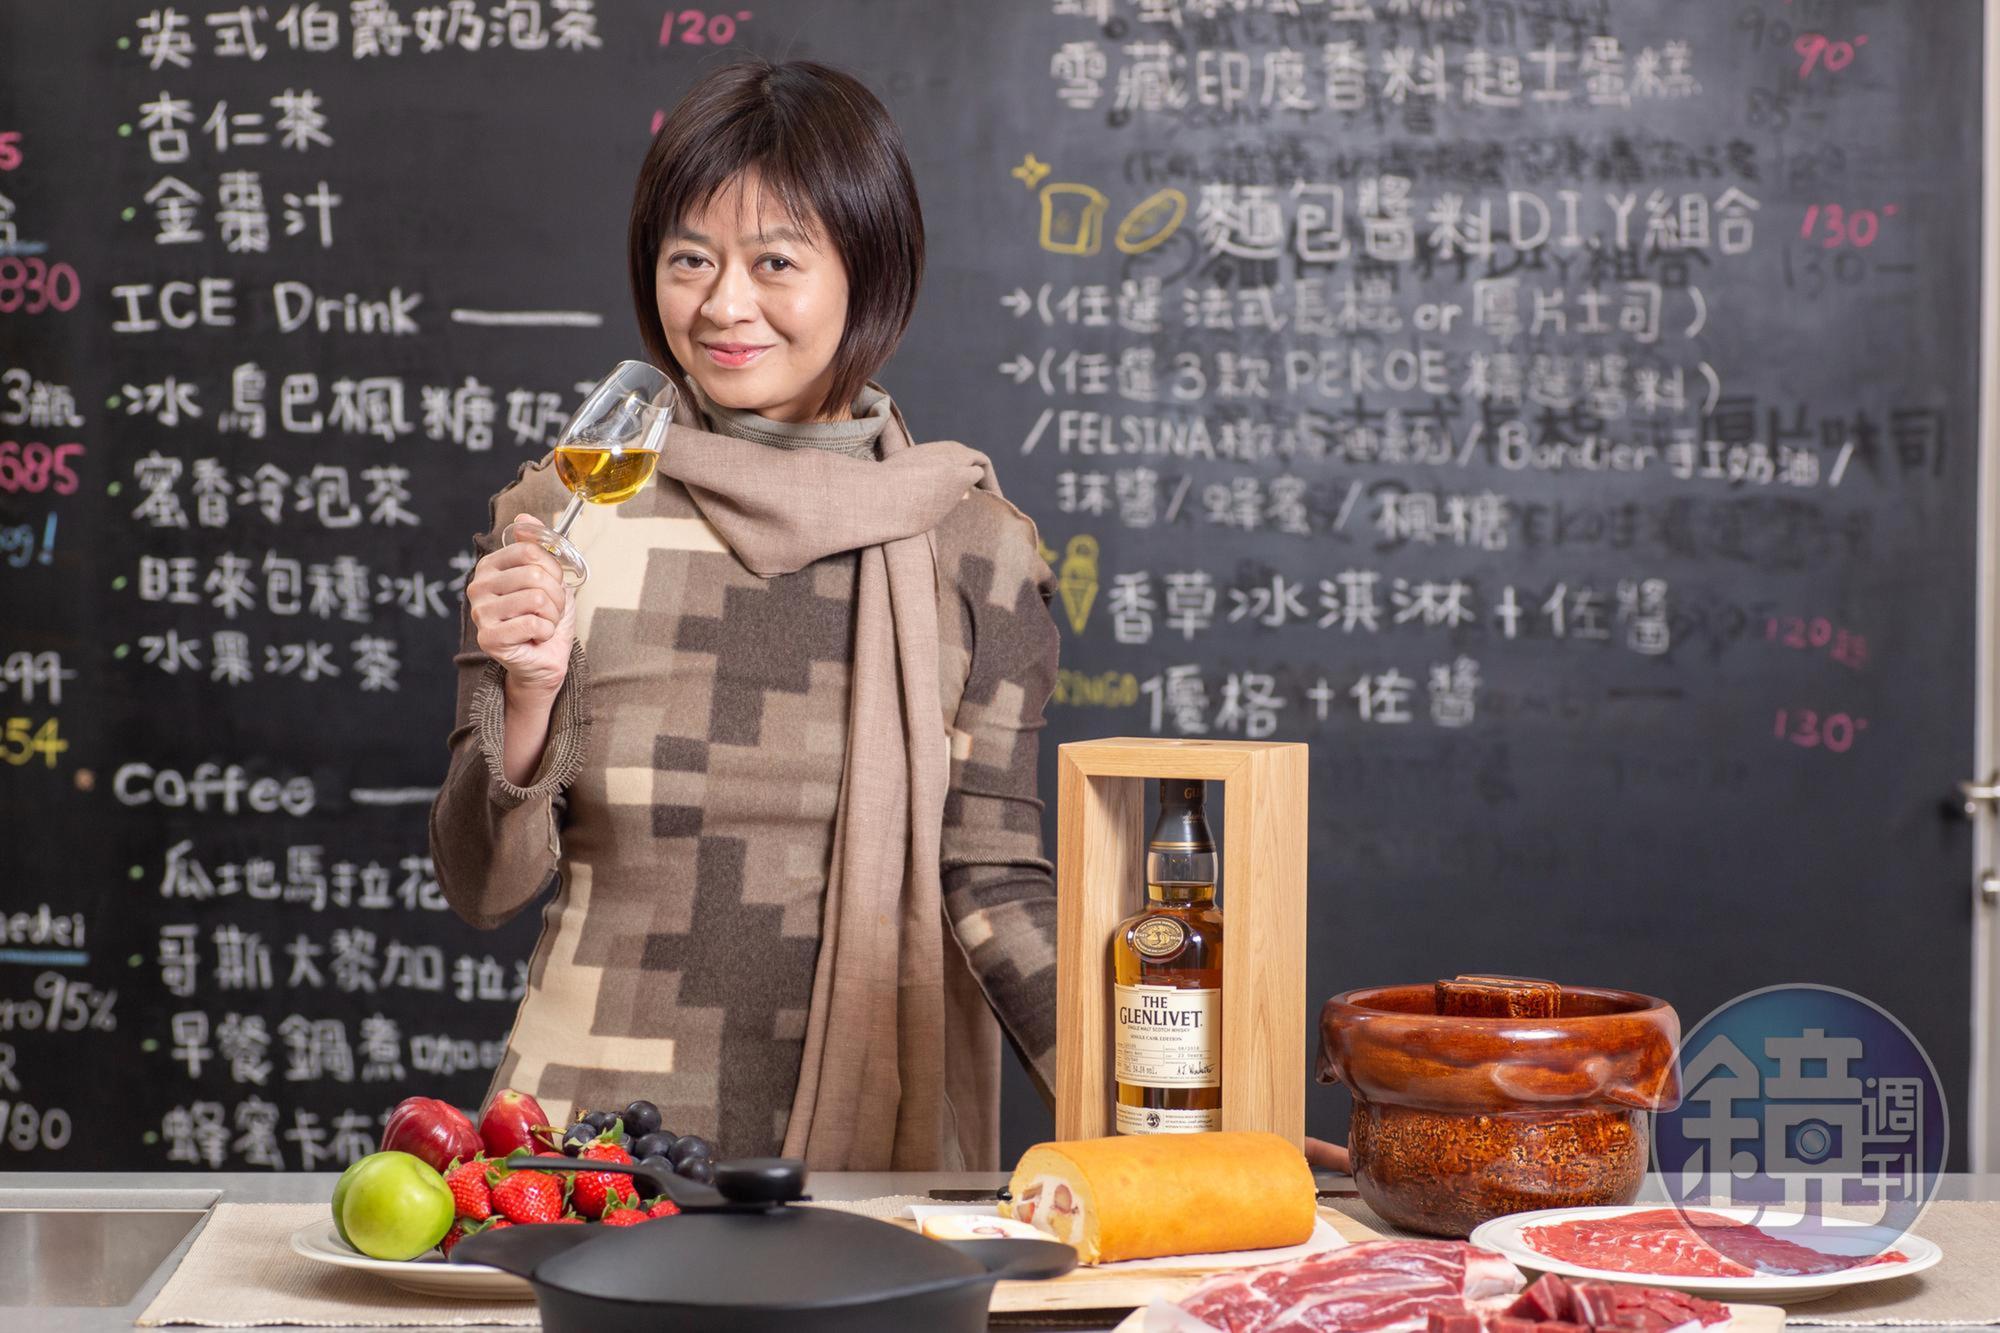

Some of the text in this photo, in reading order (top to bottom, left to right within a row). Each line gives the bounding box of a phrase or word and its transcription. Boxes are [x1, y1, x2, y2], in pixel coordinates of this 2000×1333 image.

[139, 89, 334, 163] 杏仁茶
[111, 278, 421, 334] ICE Drink
[131, 451, 420, 529] 蜜香冷泡茶
[139, 629, 401, 692] 水果冰茶
[113, 763, 316, 815] Coffee
[1142, 995, 1168, 1009] THE
